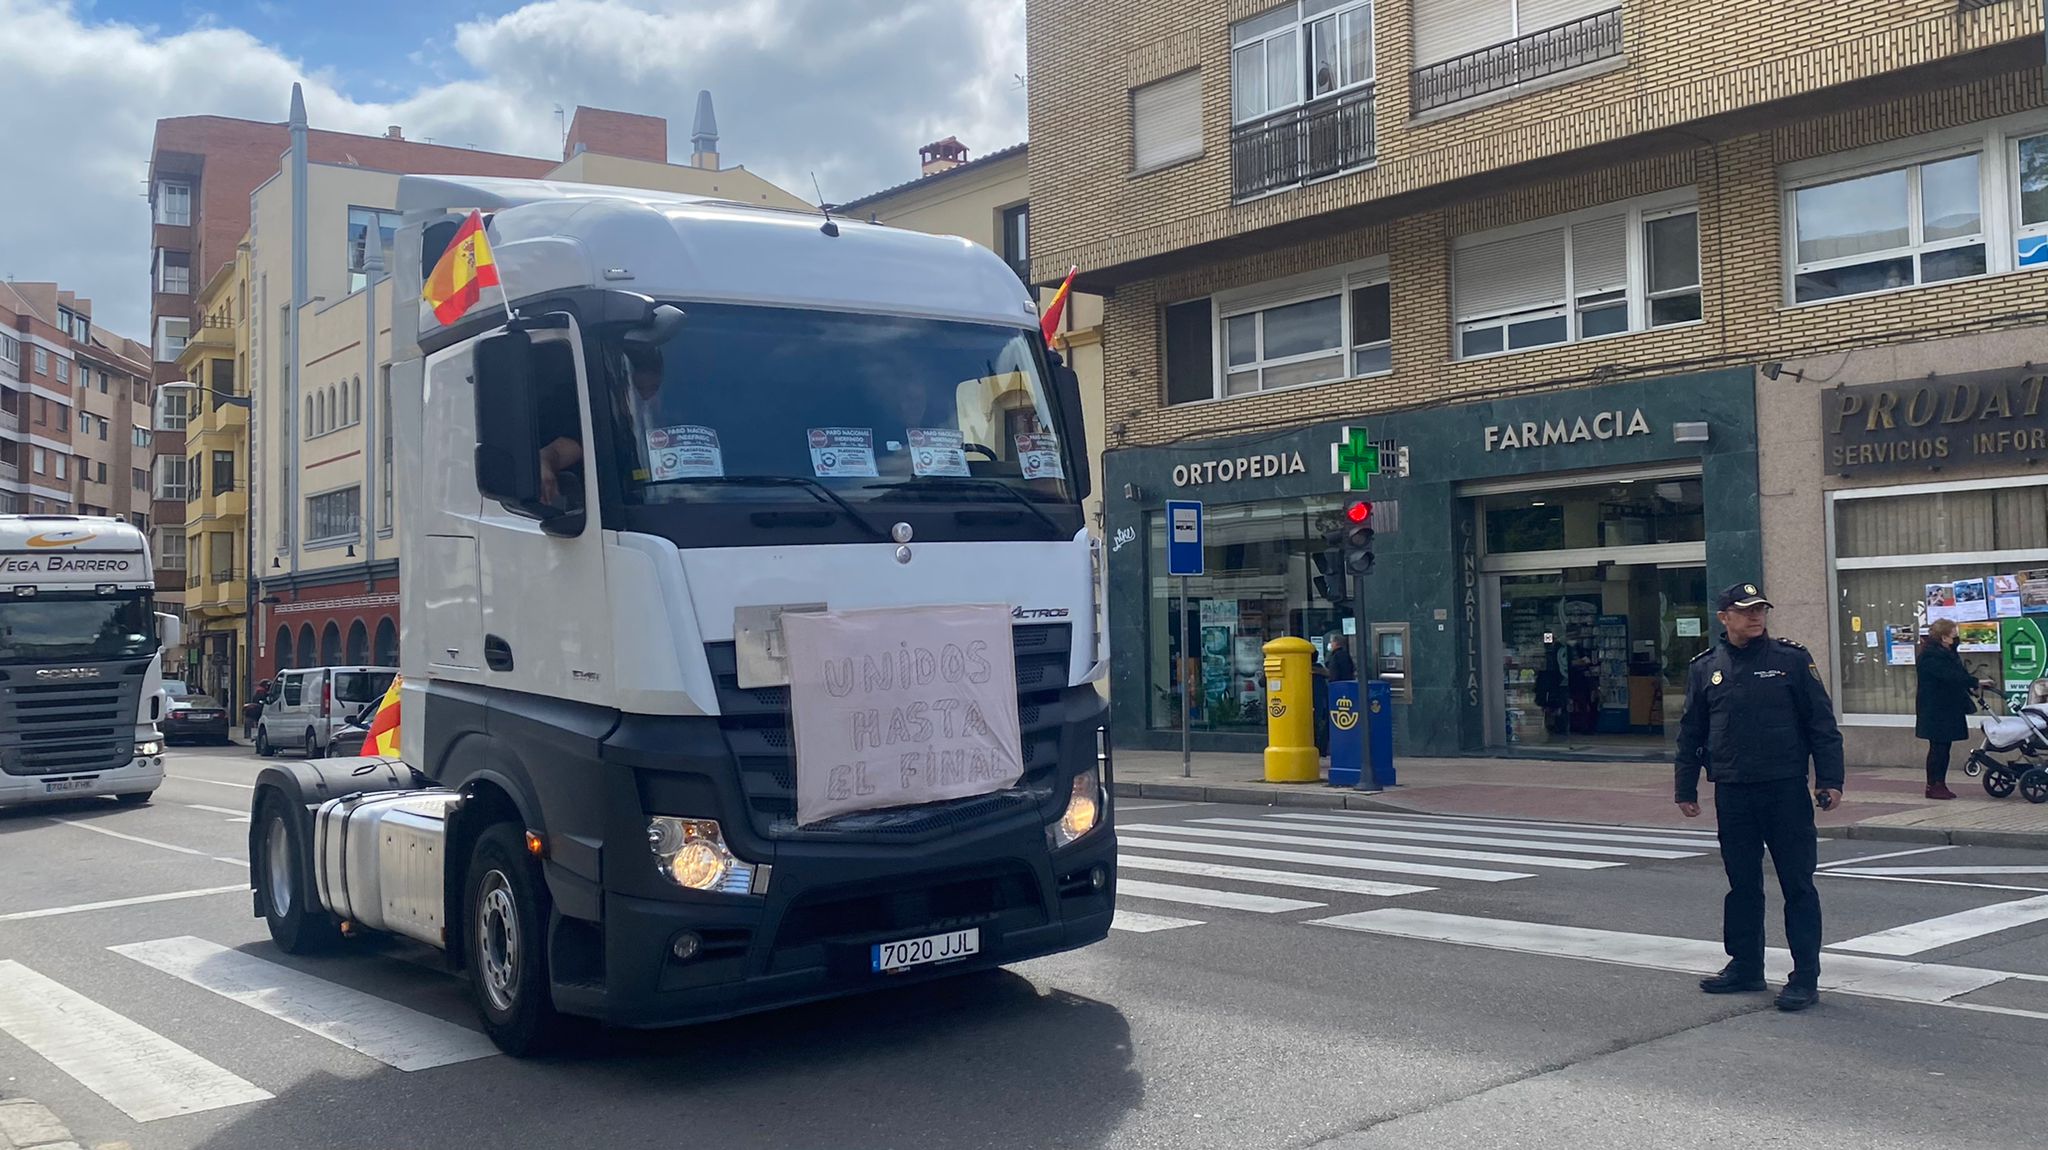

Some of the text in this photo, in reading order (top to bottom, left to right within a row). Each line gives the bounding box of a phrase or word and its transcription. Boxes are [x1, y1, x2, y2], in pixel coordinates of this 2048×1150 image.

[1484, 407, 1651, 451] FARMACIA
[1172, 450, 1306, 488] ORTOPEDIA
[1832, 437, 1949, 467] SERVICIOS
[1011, 606, 1070, 618] ACTROS
[851, 698, 988, 750] HASTA
[824, 761, 876, 800] EL
[884, 933, 974, 967] 7020 JJL
